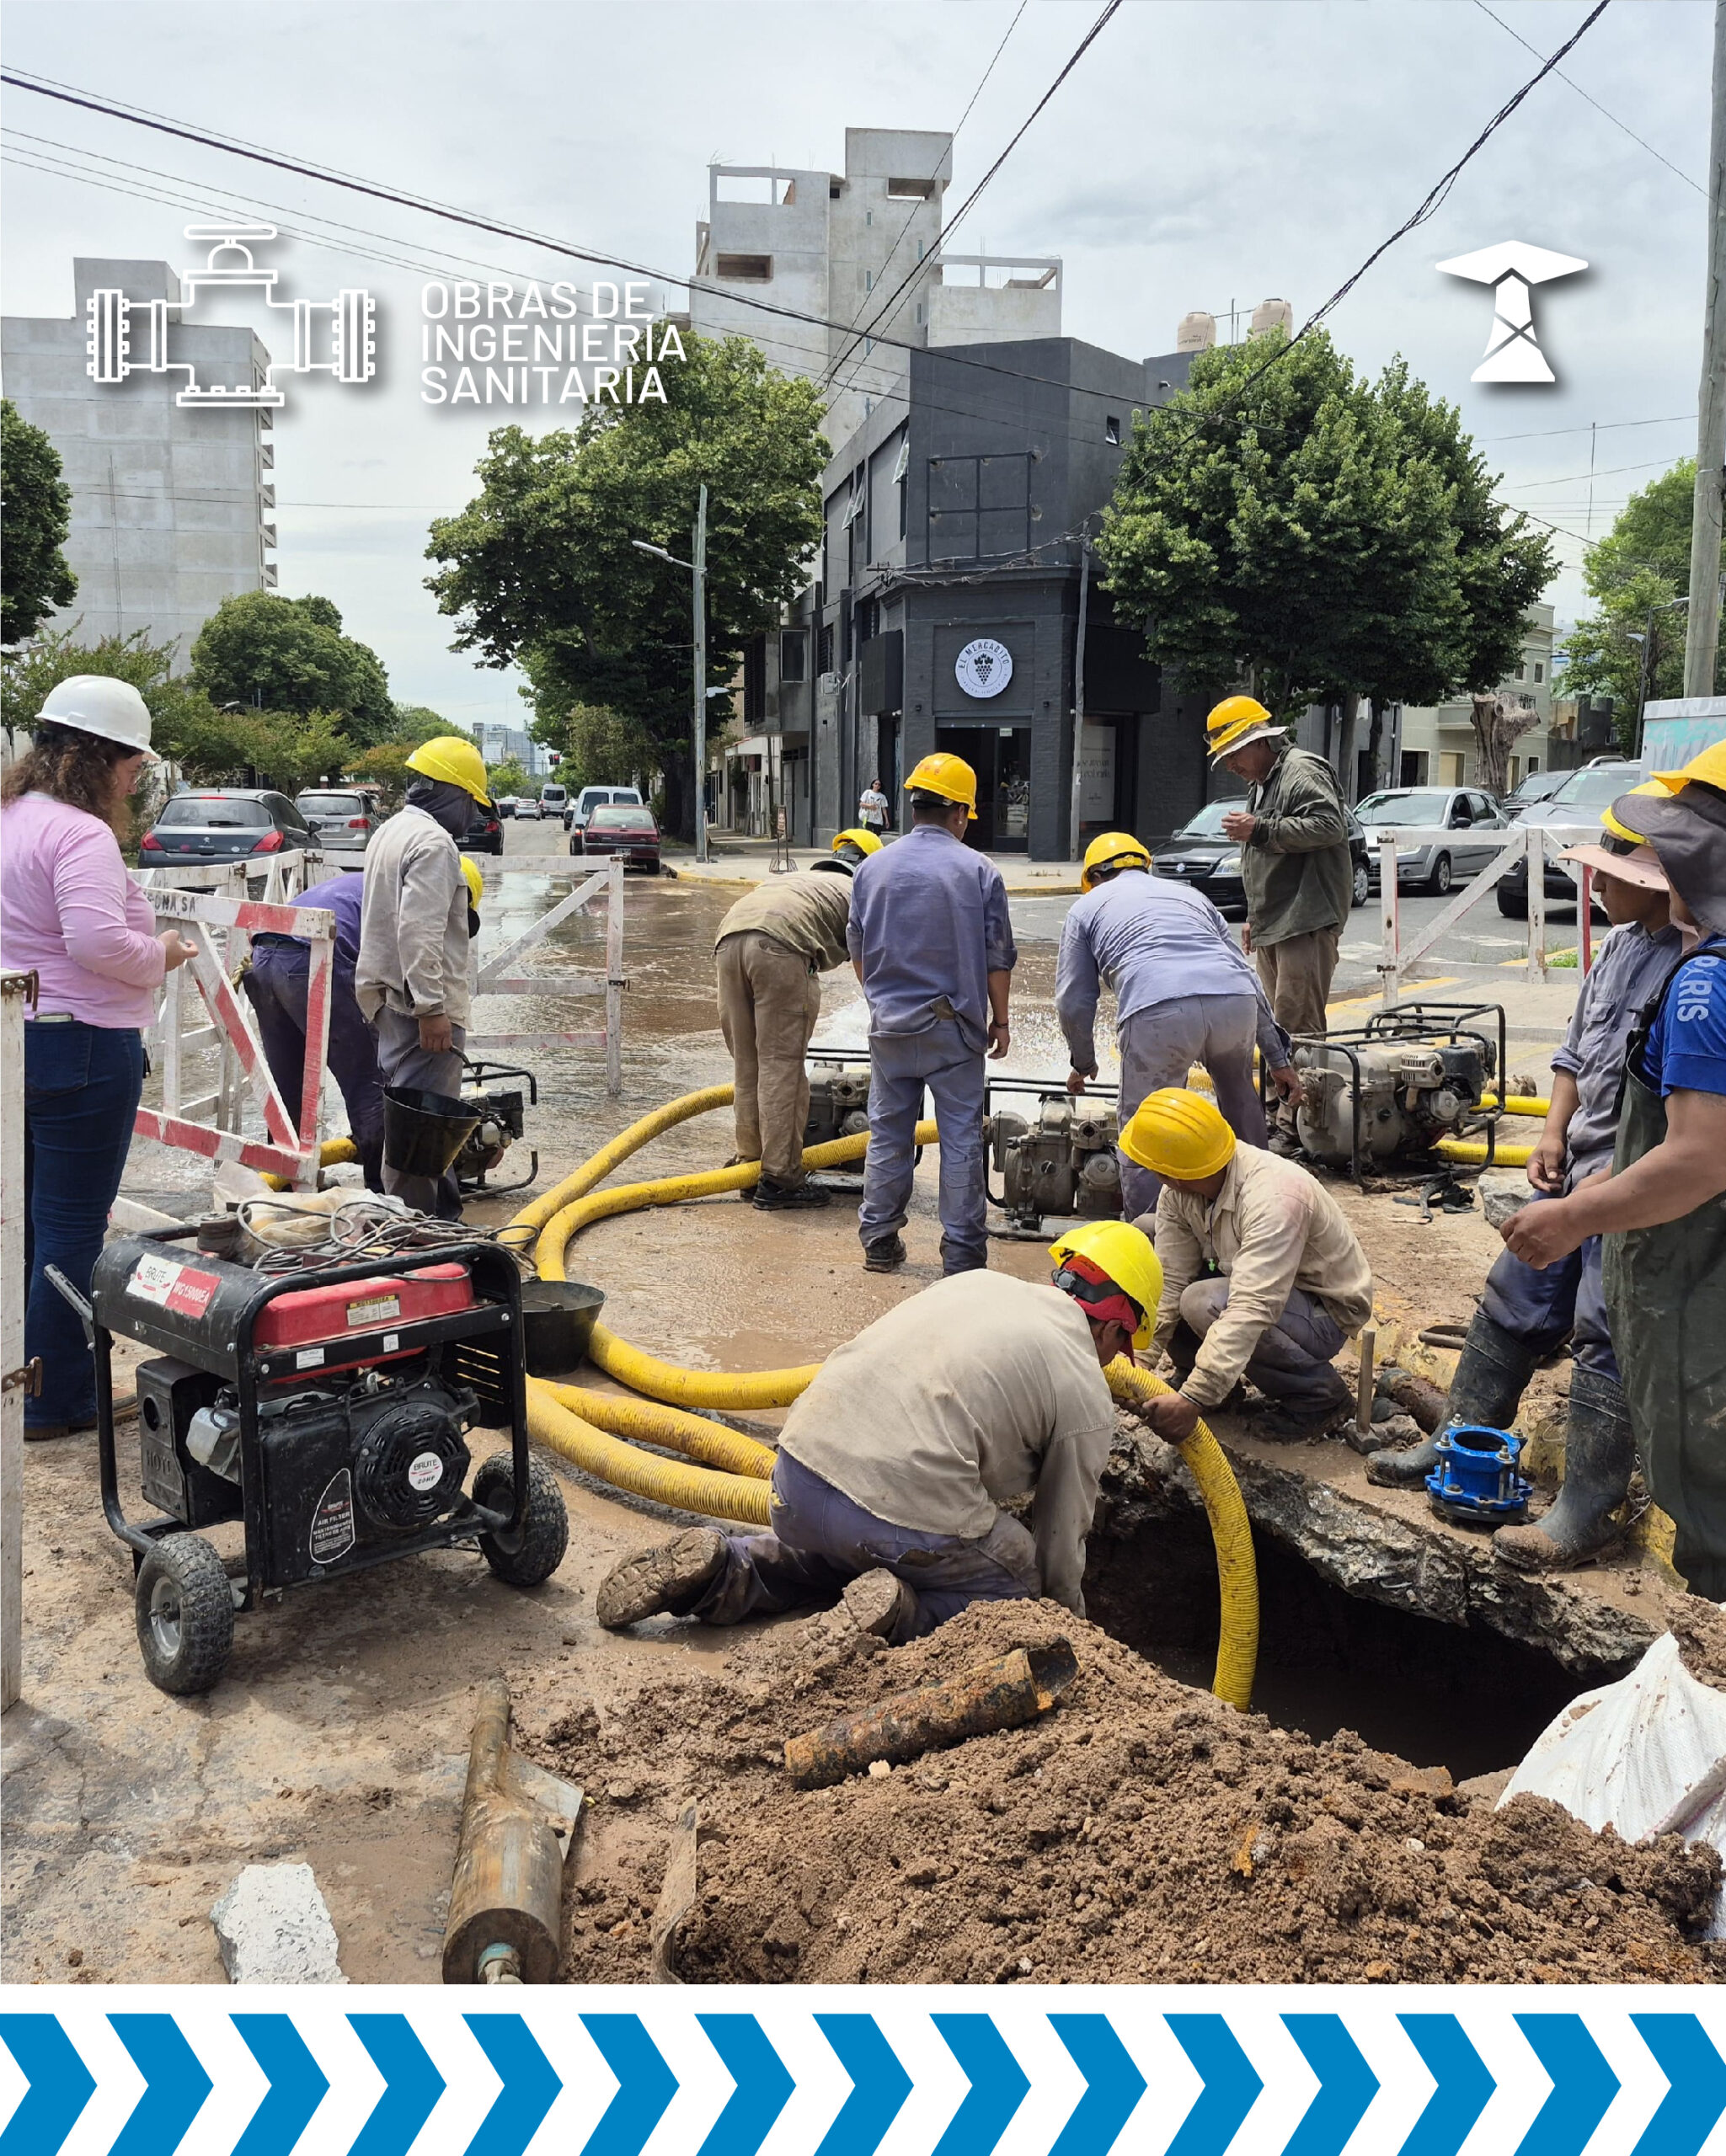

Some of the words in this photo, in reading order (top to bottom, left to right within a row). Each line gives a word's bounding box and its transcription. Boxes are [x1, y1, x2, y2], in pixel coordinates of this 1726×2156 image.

[959, 659, 967, 669] EL
[965, 642, 1010, 664] MERCADITO
[145, 1266, 167, 1283] BRUTE
[414, 1459, 437, 1470] BRUTE
[318, 1518, 329, 1527] AIR
[329, 1512, 350, 1523] FILTER
